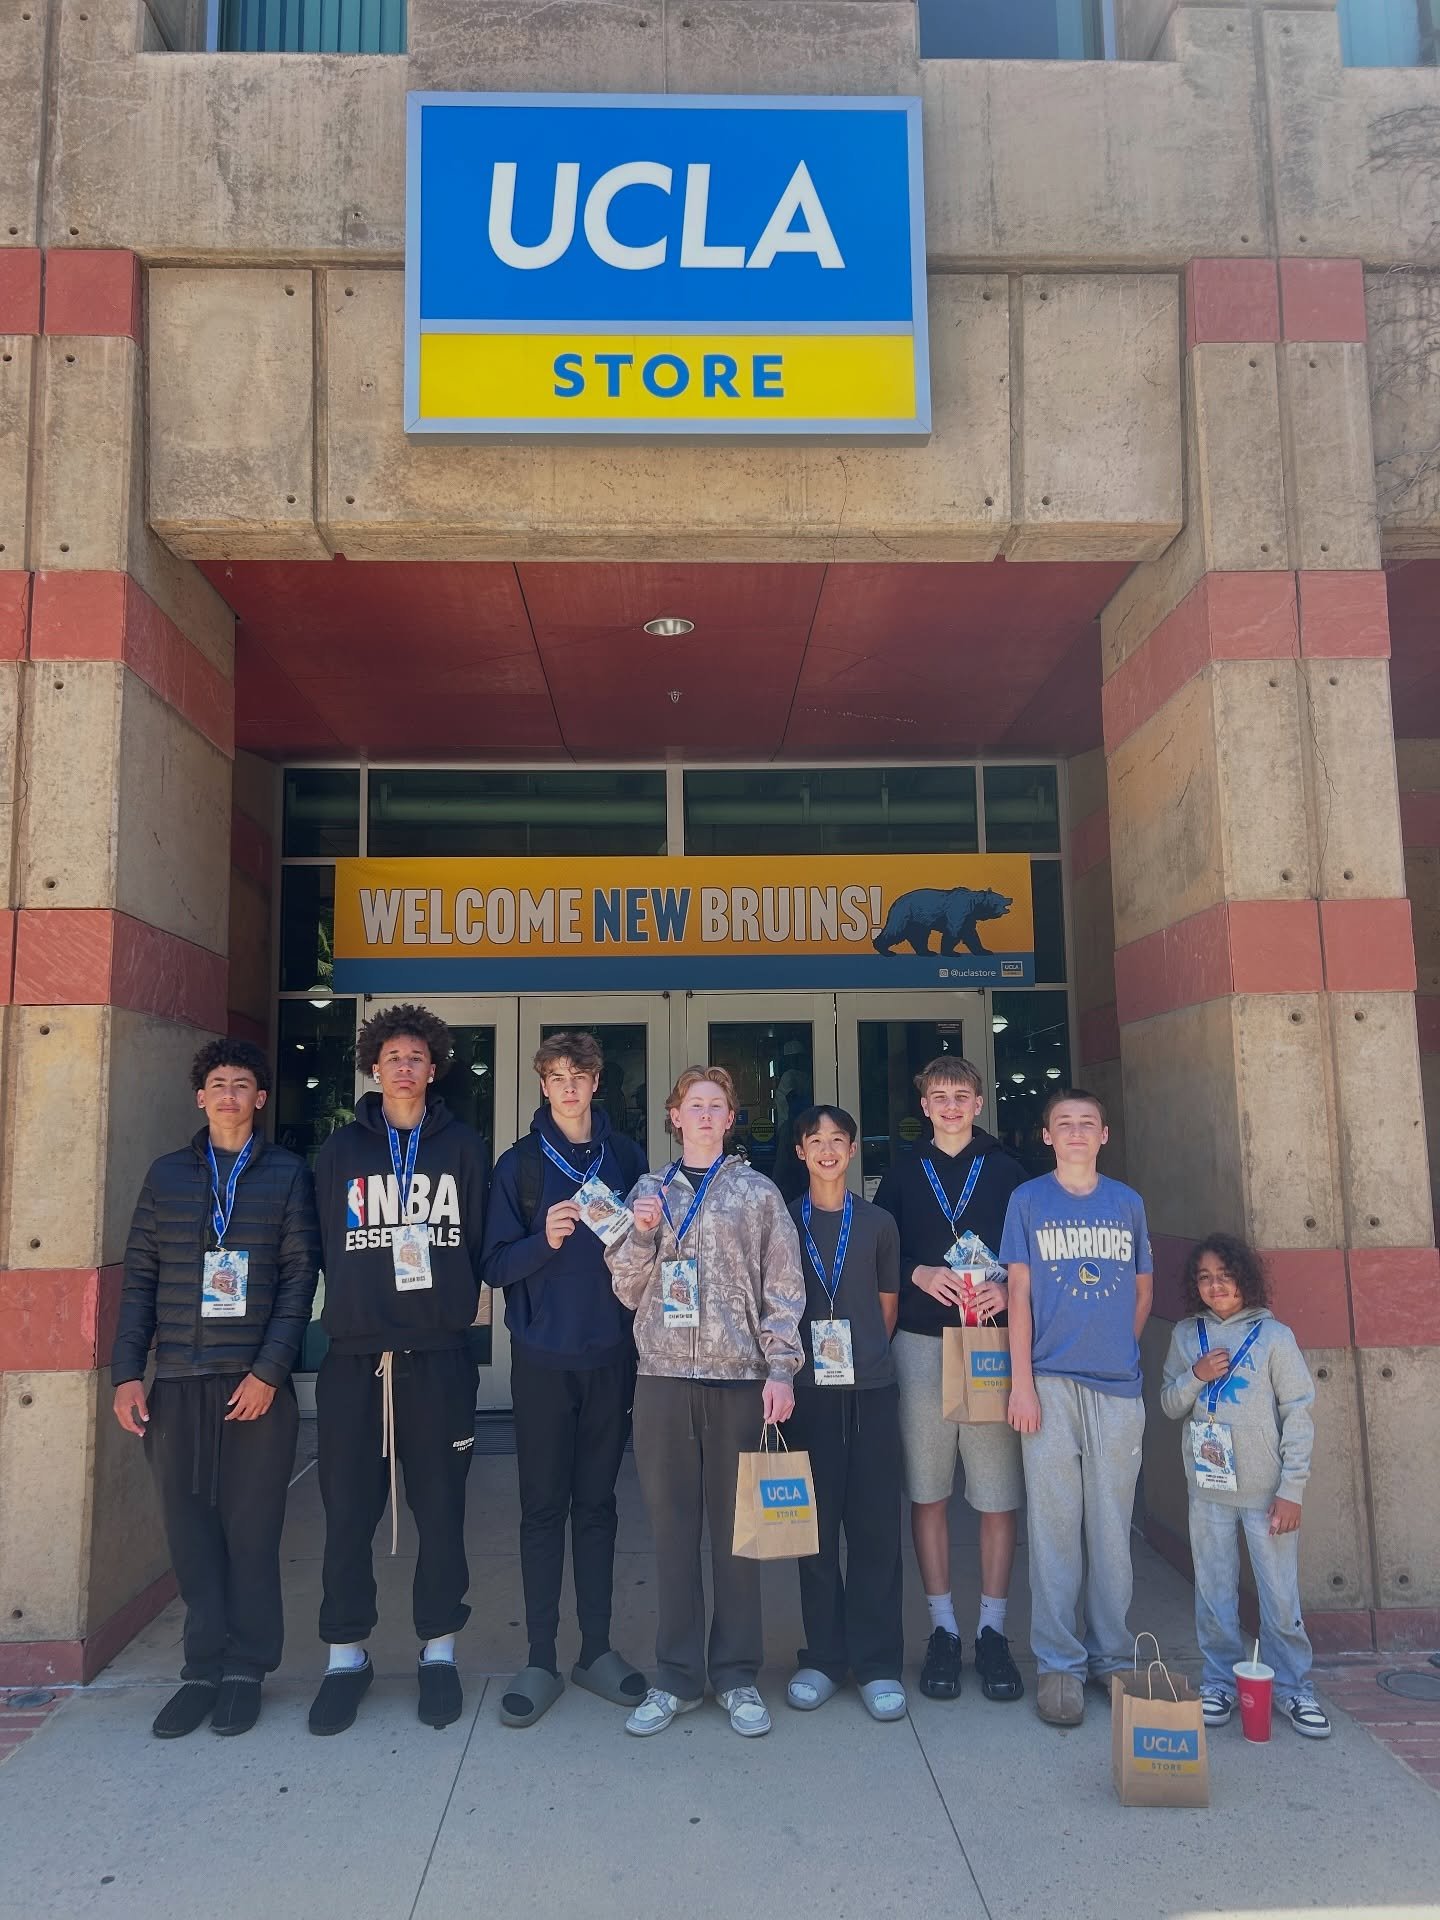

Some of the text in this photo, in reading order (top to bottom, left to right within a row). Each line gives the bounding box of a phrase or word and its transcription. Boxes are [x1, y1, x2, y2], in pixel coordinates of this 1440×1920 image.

[487, 158, 846, 271] UCLA
[553, 353, 785, 399] STORE
[359, 885, 883, 945] WELCOME NEW BRUINS!
[950, 968, 997, 977] @uclastore
[367, 1173, 461, 1226] NBA
[345, 1226, 461, 1252] ESSEALS
[1035, 1226, 1133, 1262] WARRIORS
[976, 1357, 1006, 1372] UCLA
[767, 1485, 803, 1501] UCLA
[1143, 1735, 1190, 1753] UCLA
